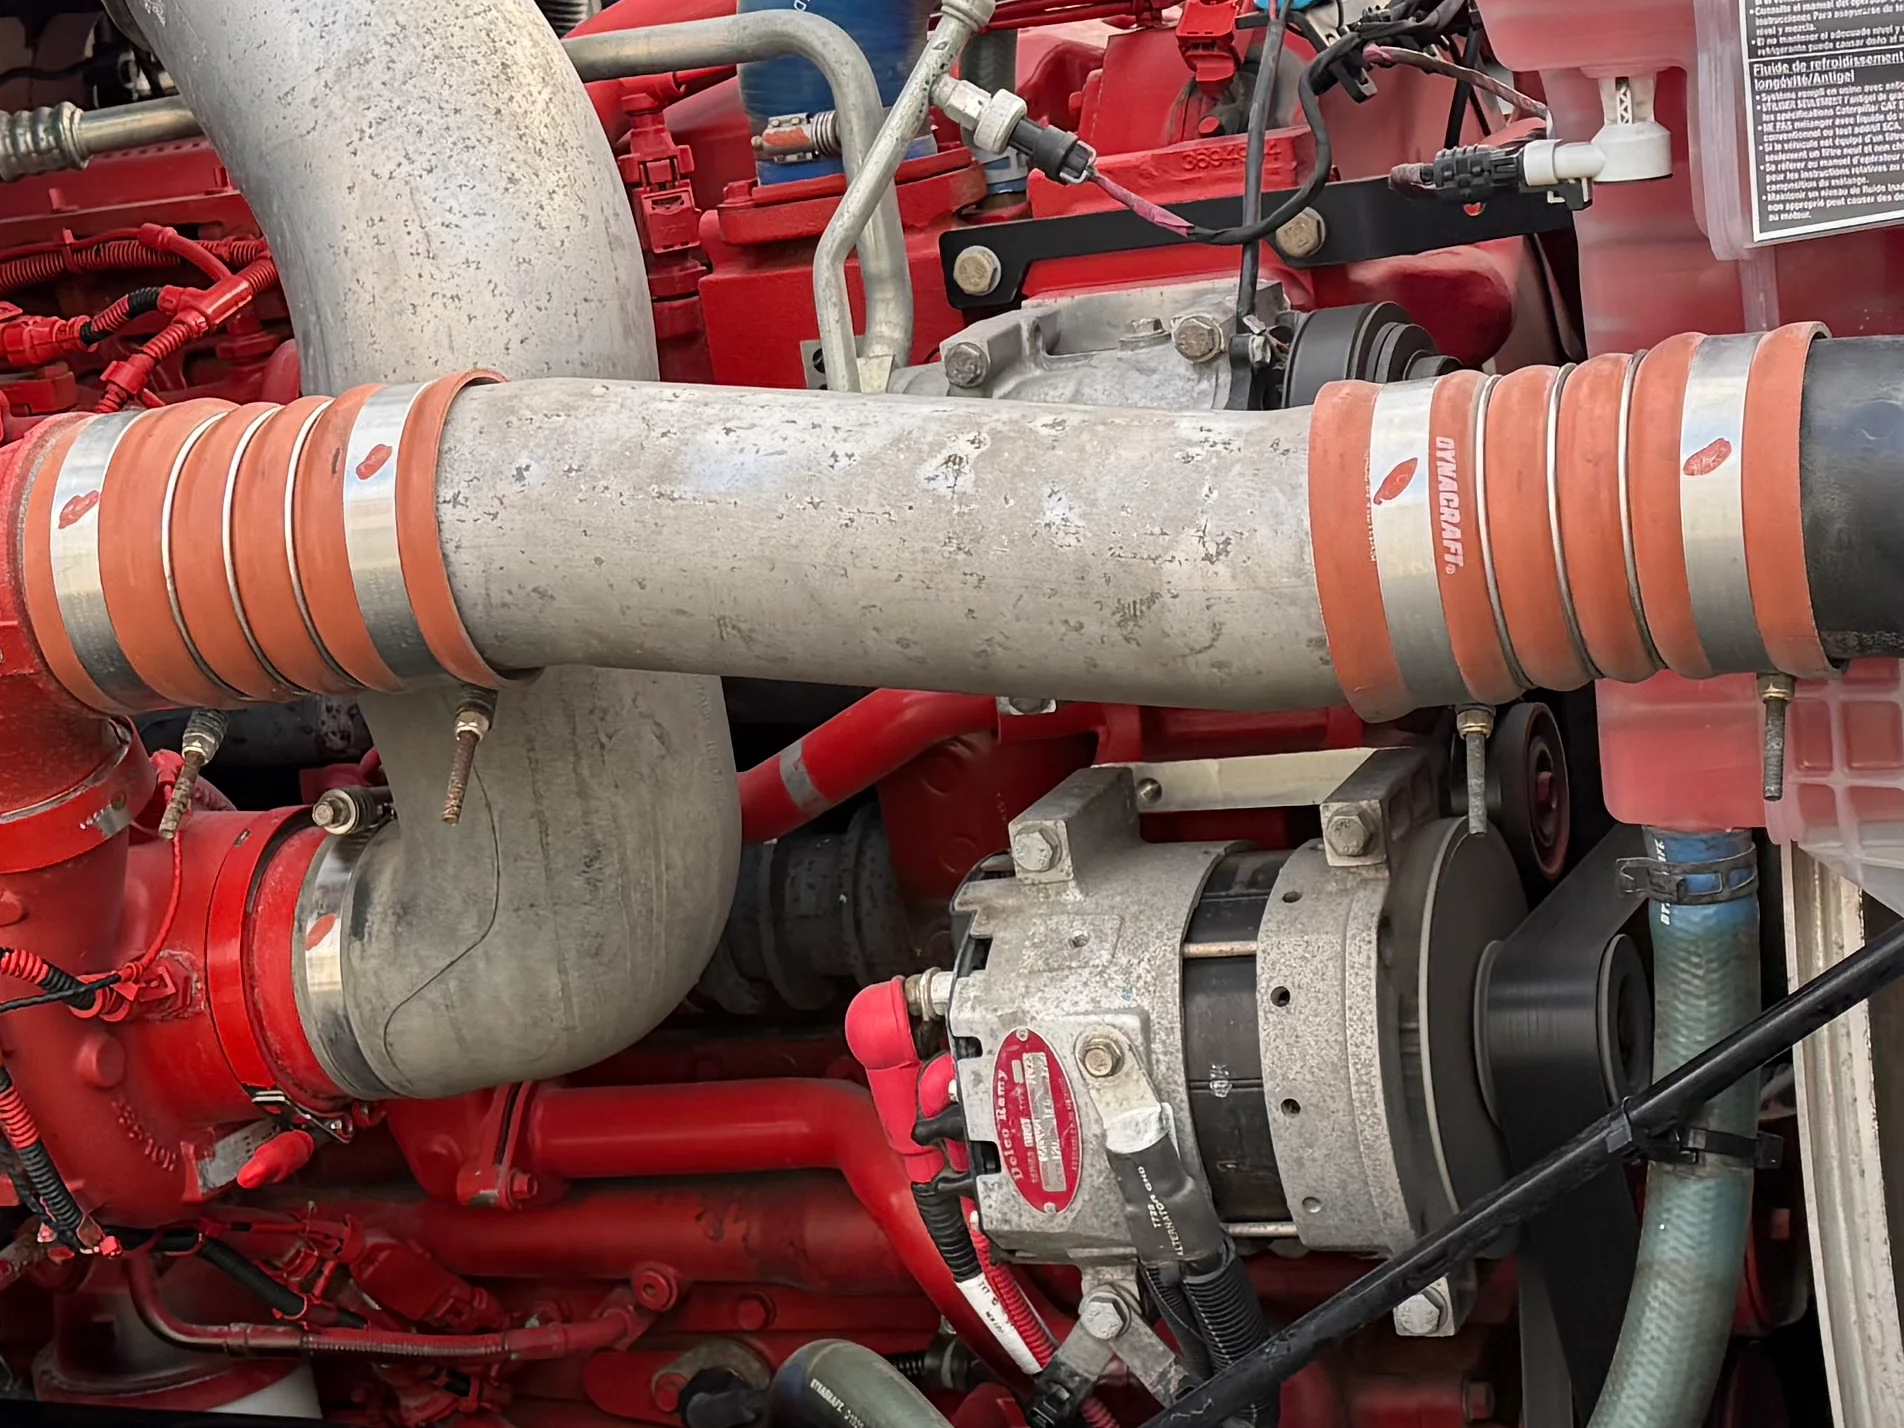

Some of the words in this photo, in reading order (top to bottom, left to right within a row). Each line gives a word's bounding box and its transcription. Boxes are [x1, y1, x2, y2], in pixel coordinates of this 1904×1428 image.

[996, 1069, 1008, 1122] Remy
[1001, 1128, 1024, 1181] Delco
[1138, 1166, 1152, 1192] GND
